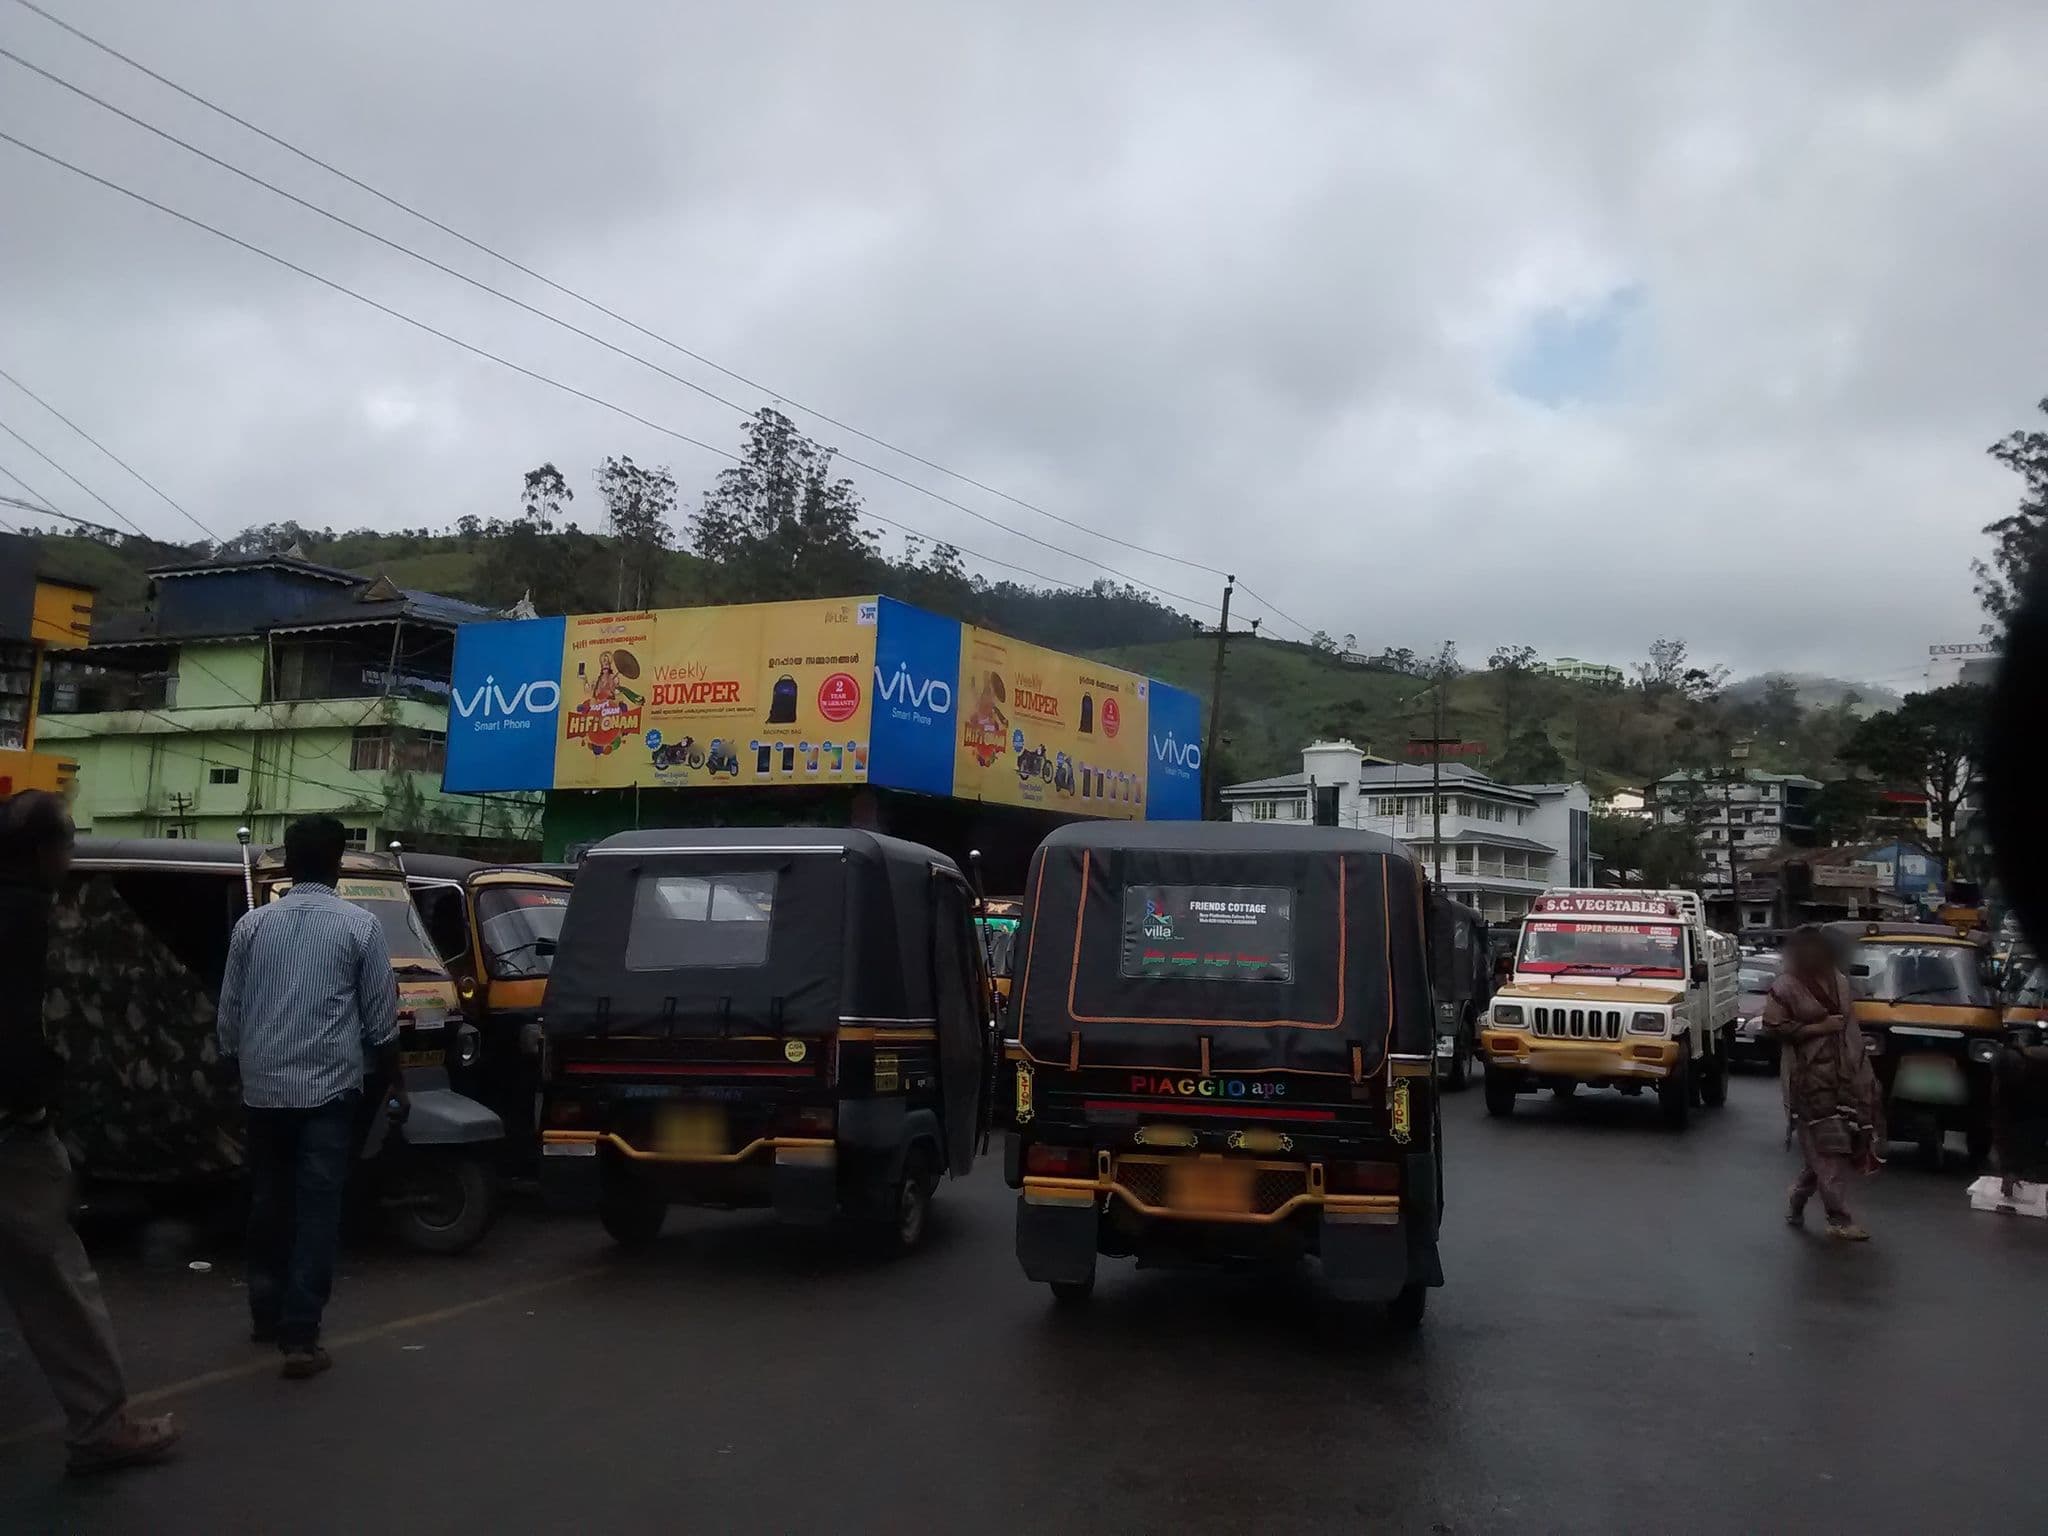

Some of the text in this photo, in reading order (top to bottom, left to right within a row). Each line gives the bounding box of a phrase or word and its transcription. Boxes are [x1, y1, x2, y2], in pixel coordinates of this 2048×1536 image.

[654, 661, 708, 681] Weekly
[451, 674, 560, 718] vivo
[651, 681, 740, 706] BUMPER
[835, 681, 844, 693] 2
[874, 661, 951, 714] vivo
[1014, 688, 1059, 717] BUMPER
[474, 719, 532, 732] Smart Phone
[1152, 730, 1201, 769] vivo
[1190, 901, 1267, 914] FRIENDS COTTAGE
[1546, 899, 1666, 914] S.C. VEGETABLES
[1144, 925, 1171, 938] villa
[1129, 1076, 1286, 1099] PIAGGIO ape
